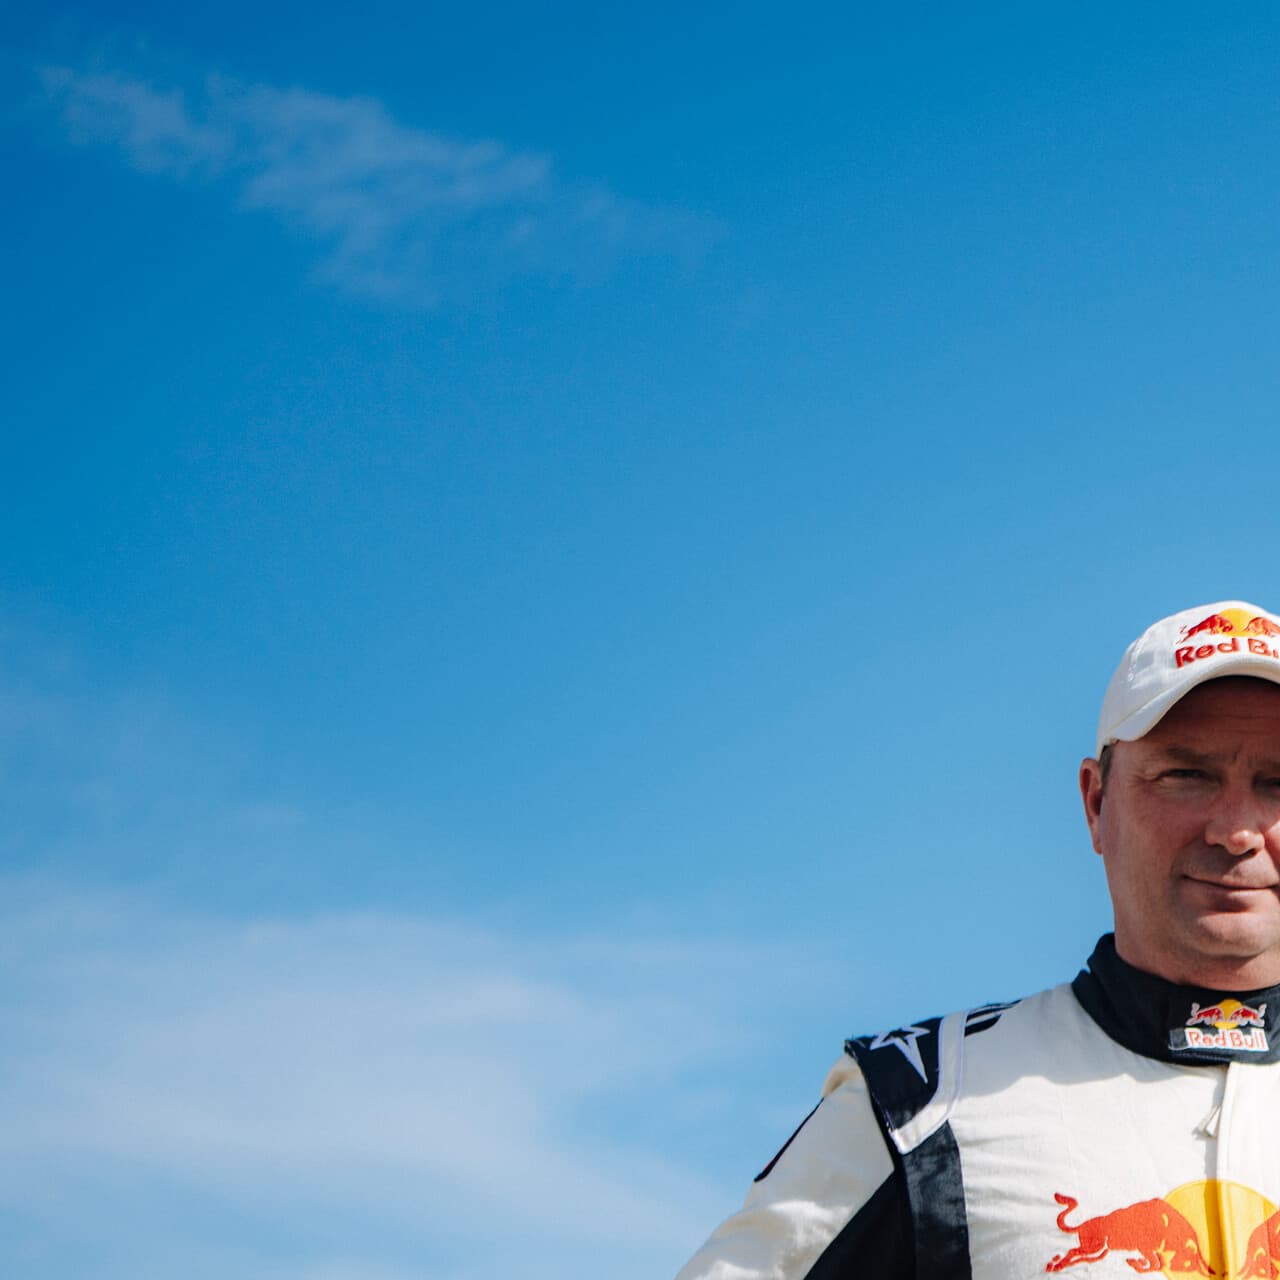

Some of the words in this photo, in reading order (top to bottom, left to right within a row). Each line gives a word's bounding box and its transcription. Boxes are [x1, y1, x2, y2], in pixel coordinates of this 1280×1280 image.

[1175, 638, 1240, 668] Red
[1188, 1030, 1226, 1047] Red
[1229, 1031, 1265, 1049] Bull
